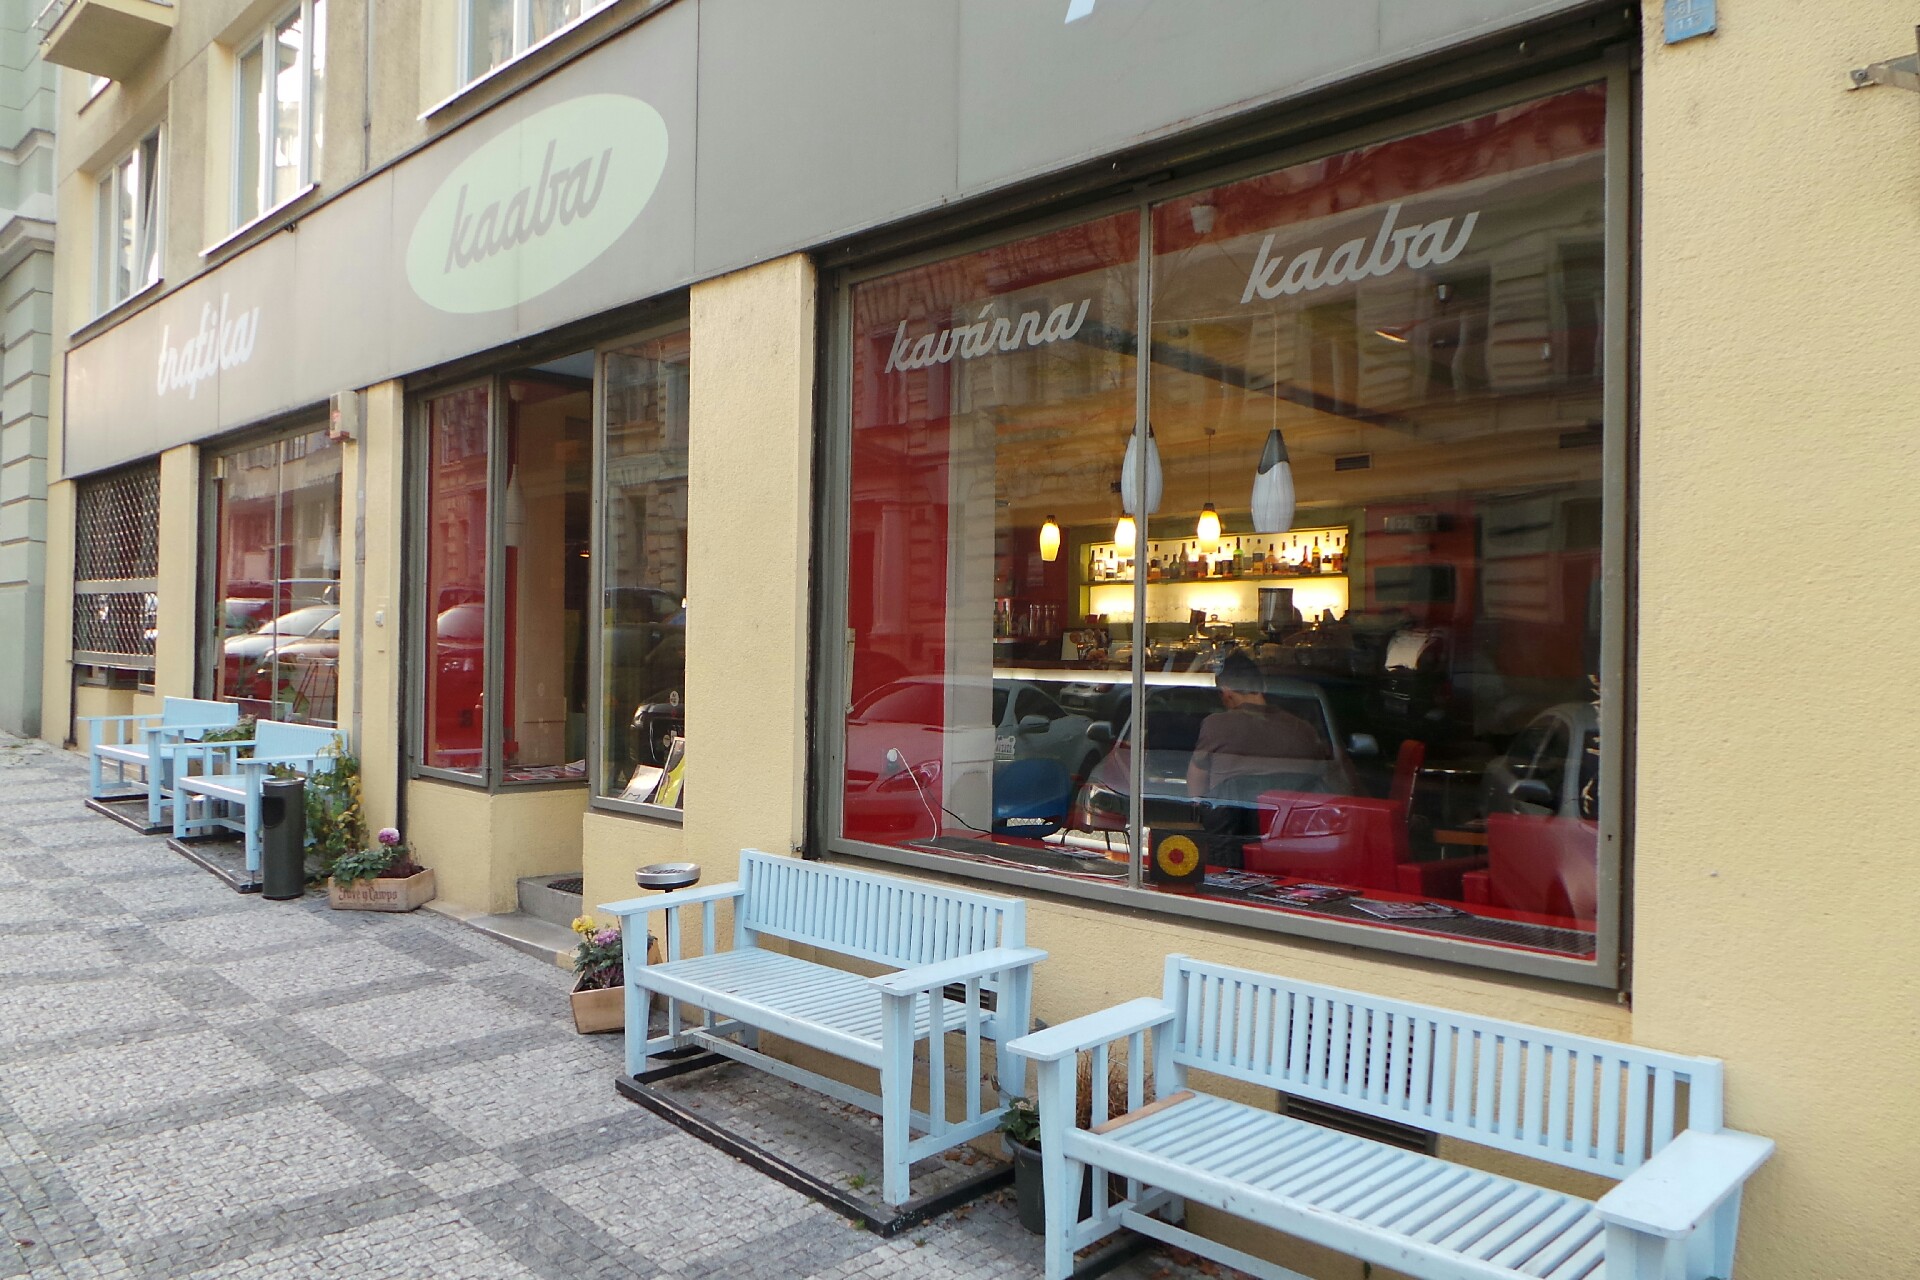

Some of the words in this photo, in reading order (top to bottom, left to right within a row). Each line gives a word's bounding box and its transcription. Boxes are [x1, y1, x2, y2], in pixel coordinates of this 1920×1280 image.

[443, 139, 613, 274] kaaba
[1241, 202, 1480, 305] kaaba
[157, 293, 260, 399] trafika
[885, 297, 1091, 374] kavárna
